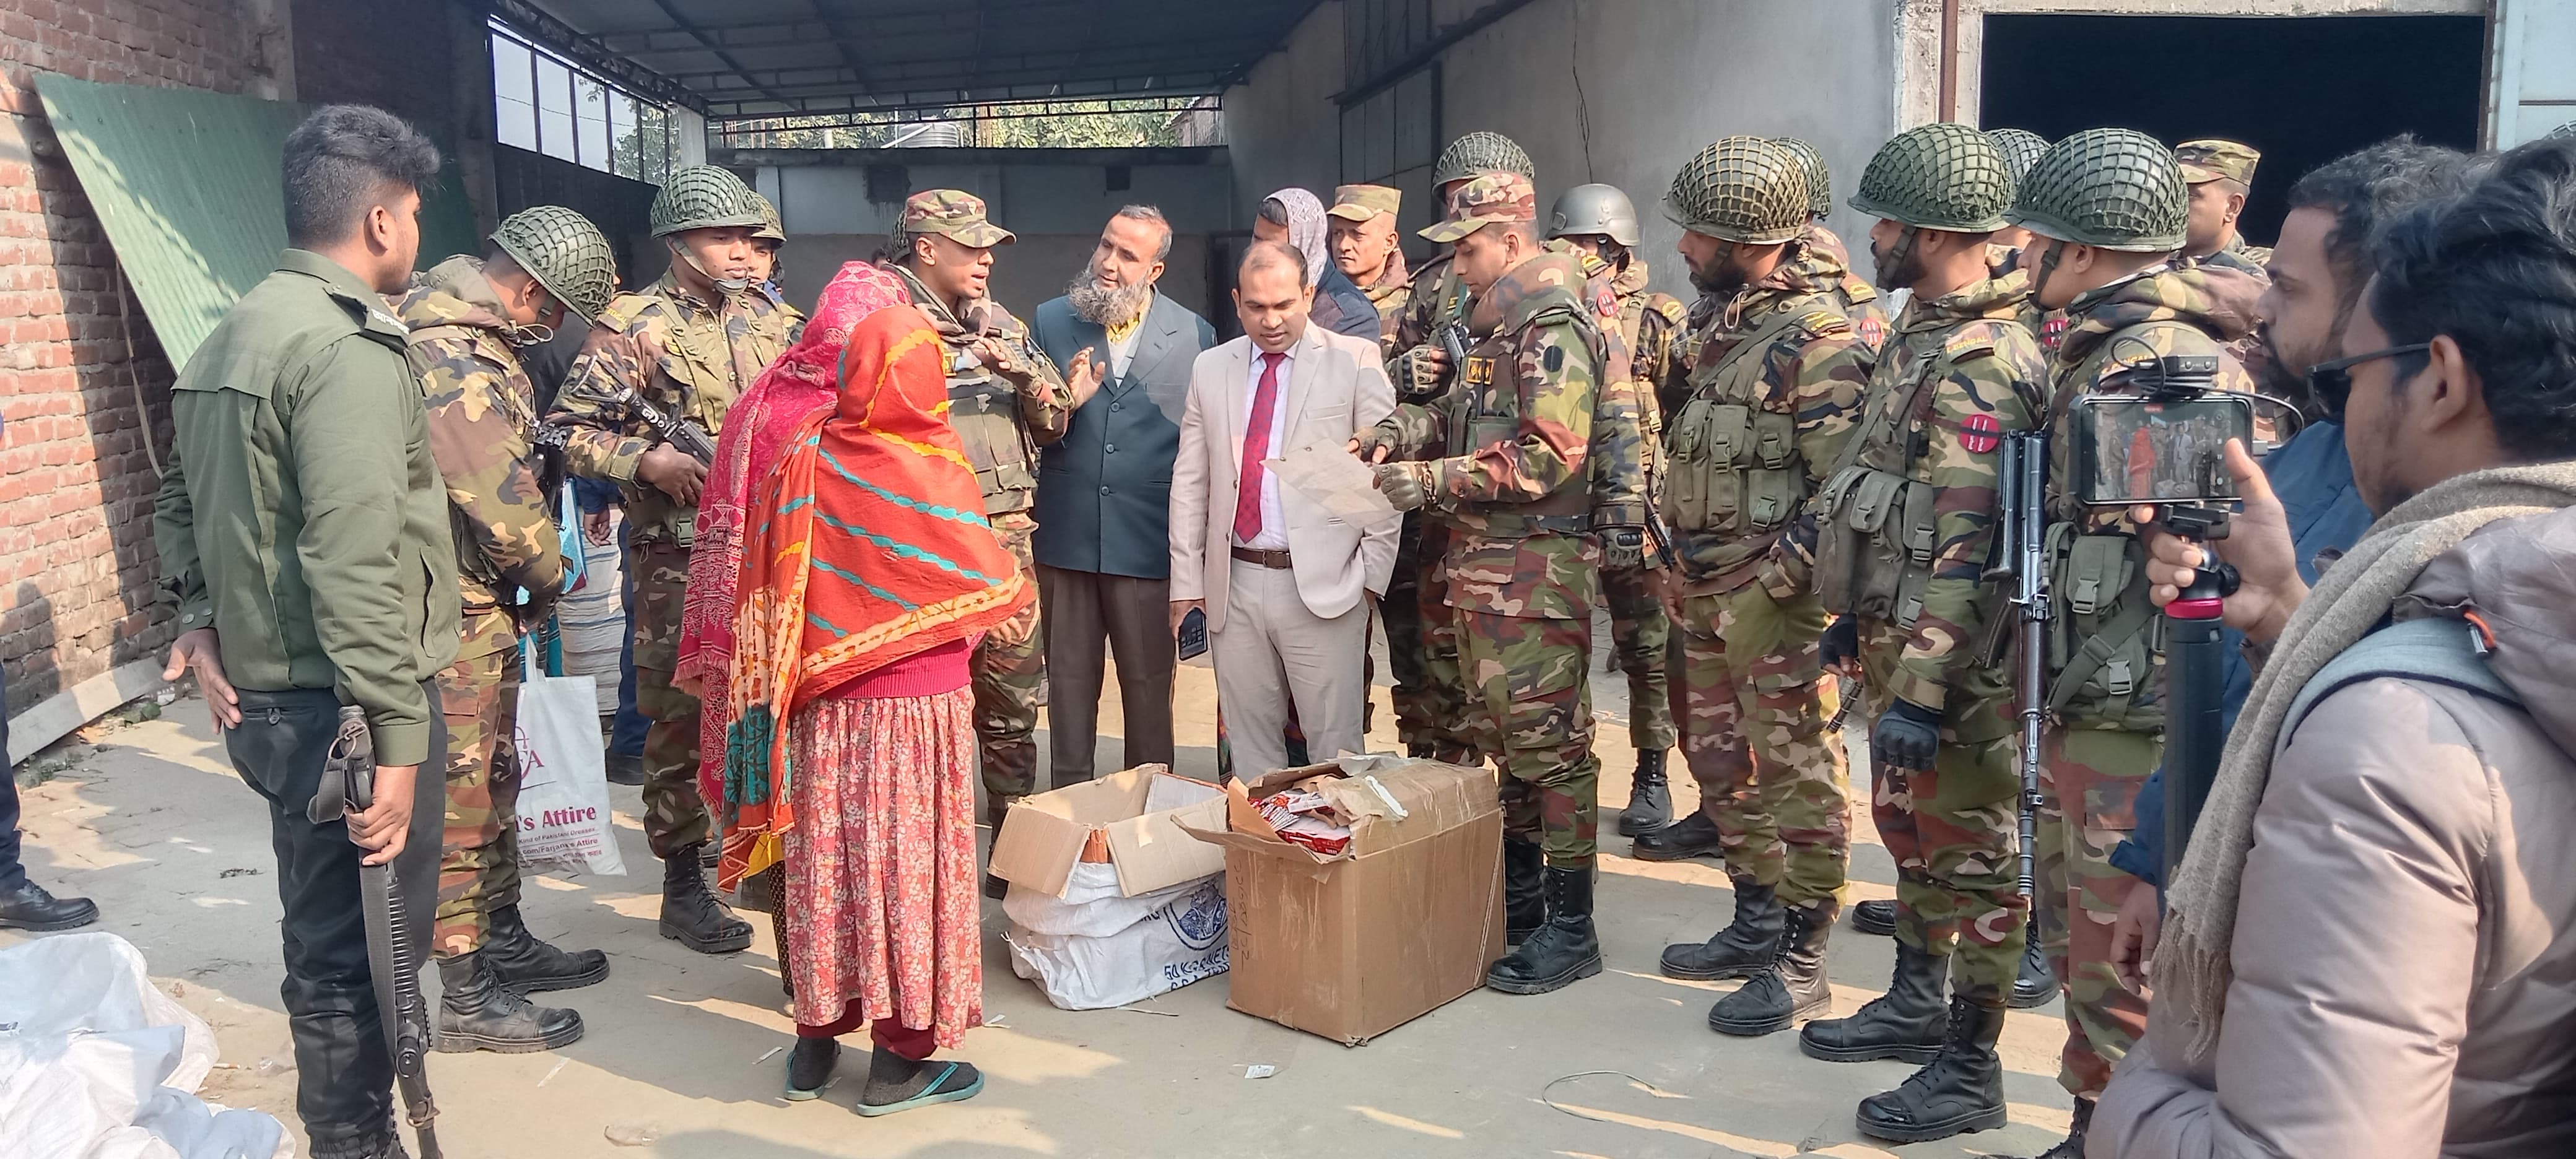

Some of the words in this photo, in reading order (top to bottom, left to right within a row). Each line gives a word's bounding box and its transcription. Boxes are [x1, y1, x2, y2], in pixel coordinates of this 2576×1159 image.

[1953, 336, 1989, 351] BENGAL
[2110, 355, 2148, 370] BNGAL
[542, 806, 597, 828] Attire
[541, 831, 569, 840] Pakistani
[570, 827, 596, 836] Dresses
[577, 838, 598, 848] Attire
[1164, 964, 1180, 980] 50
